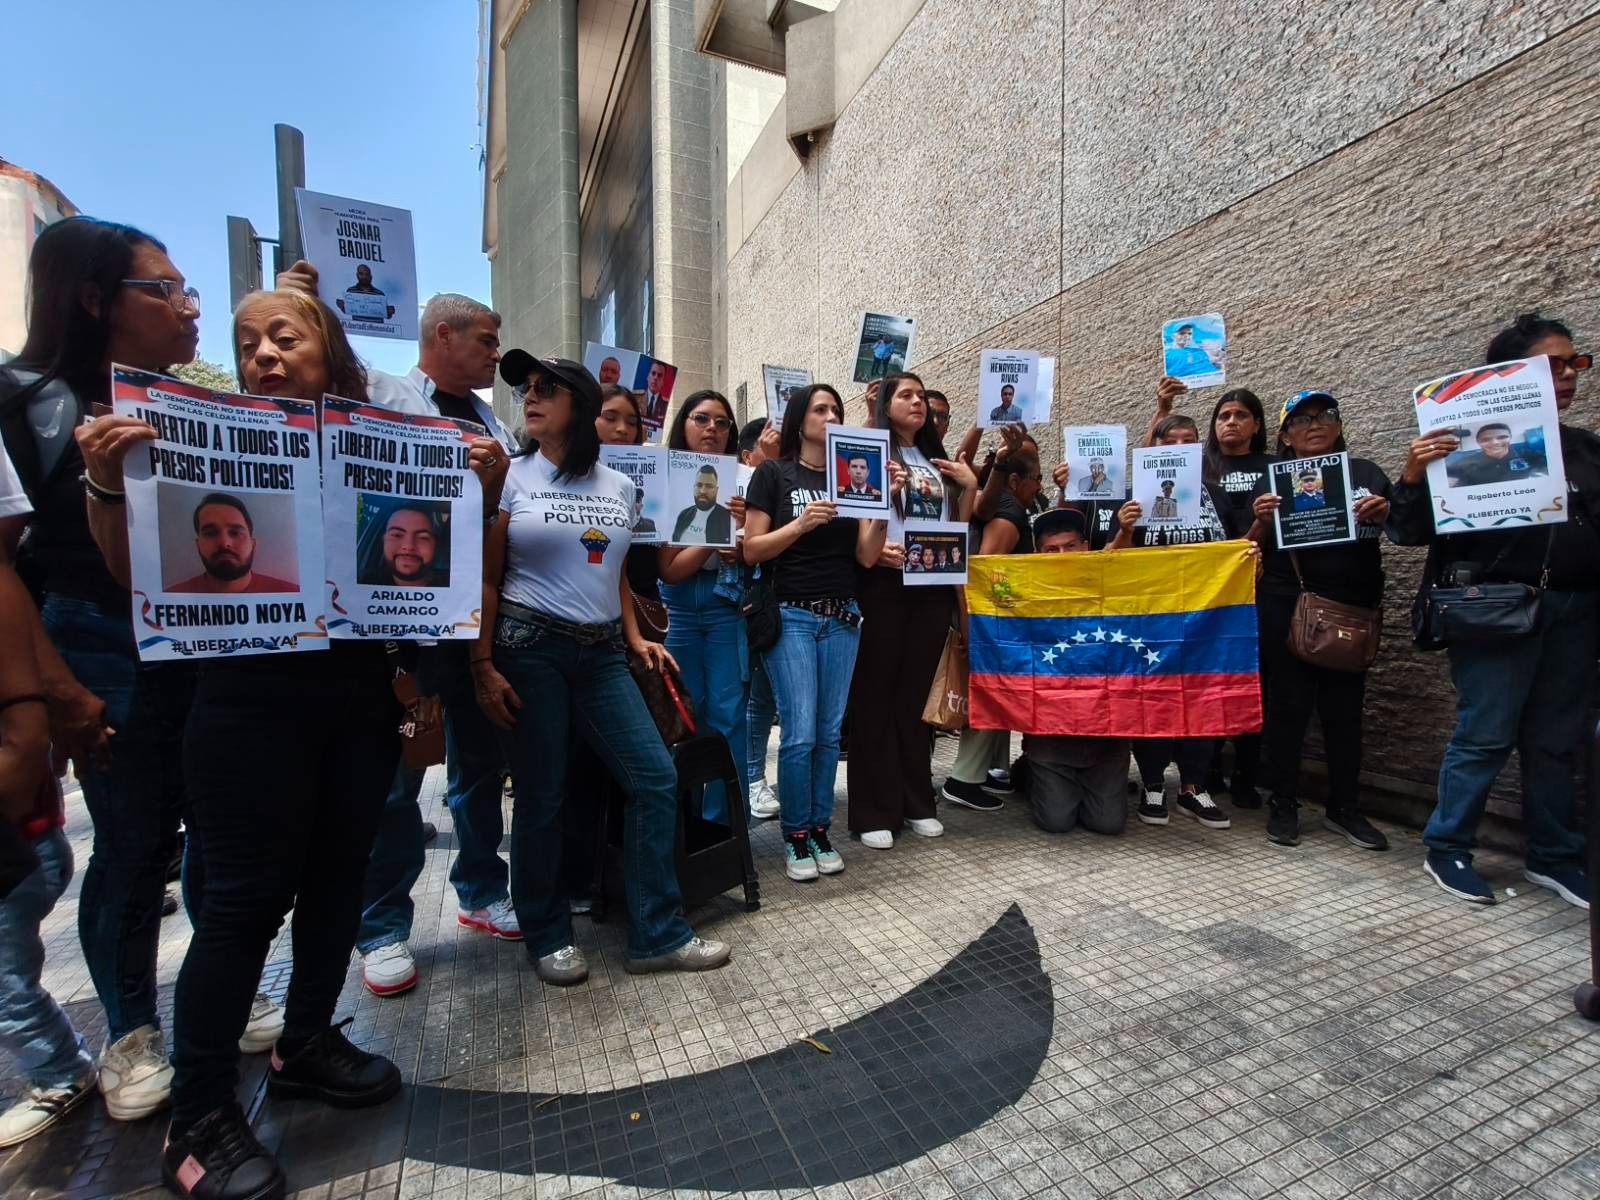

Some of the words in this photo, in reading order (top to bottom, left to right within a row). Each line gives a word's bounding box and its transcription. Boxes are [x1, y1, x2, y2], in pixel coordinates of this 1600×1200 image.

[336, 219, 381, 242] JOSNAR
[338, 238, 385, 263] BADUEL
[990, 362, 1029, 373] HENRYBERTH
[1001, 374, 1018, 384] RIVAS
[1463, 388, 1497, 400] DEMOCRACIA
[1501, 395, 1521, 403] CELDAS
[1522, 392, 1542, 400] LLENAS
[150, 390, 162, 399] LA
[164, 394, 219, 411] DEMOCRACIA
[248, 410, 283, 419] NEGOCIA
[167, 403, 185, 412] CON
[188, 408, 202, 416] LAS
[204, 411, 236, 421] CELDAS
[238, 417, 269, 425] LLENAS
[1462, 410, 1480, 418] TODOS
[1481, 408, 1492, 416] LOS
[1493, 404, 1514, 413] PRESOS
[362, 417, 407, 431] DEMOCRACIA
[431, 428, 460, 436] NEGOCIA
[213, 424, 223, 451] A
[227, 426, 278, 456] TODOS
[282, 431, 310, 458] LOS
[395, 430, 422, 440] CELDAS
[1078, 438, 1111, 448] ENMANUEL
[331, 430, 396, 463] ¡LIBERTAD
[400, 442, 408, 465] A
[413, 444, 453, 469] TODOS
[457, 447, 470, 470] LO
[1079, 448, 1087, 456] DE
[1088, 448, 1095, 456] LA
[1096, 448, 1113, 456] ROSA
[149, 446, 206, 483] PRESOS
[210, 455, 294, 490] POLÍTICOS!
[639, 460, 656, 474] JOSÉ
[1144, 460, 1158, 469] LUIS
[1159, 458, 1187, 468] MANUEL
[1274, 456, 1340, 475] LIBERTAD
[344, 462, 392, 493] PRESOS
[396, 468, 463, 498] POLÍTICOS!
[1156, 469, 1177, 479] PAIVA
[531, 492, 583, 501] ¡LIBEREN
[1467, 491, 1512, 501] Rigoberto
[552, 504, 576, 512] LOS
[1467, 508, 1517, 518] #LIBERTAD
[1144, 532, 1159, 545] DE
[1165, 530, 1204, 544] TODOS
[371, 590, 435, 601] ARIALDO
[155, 604, 249, 627] FERNANDO
[256, 603, 306, 624] NOYA
[367, 605, 438, 615] CAMARGO
[352, 624, 429, 634] #LIBERTAD
[434, 624, 456, 634] YA!
[172, 637, 265, 652] #LIBERTAD
[270, 635, 297, 648] YA!
